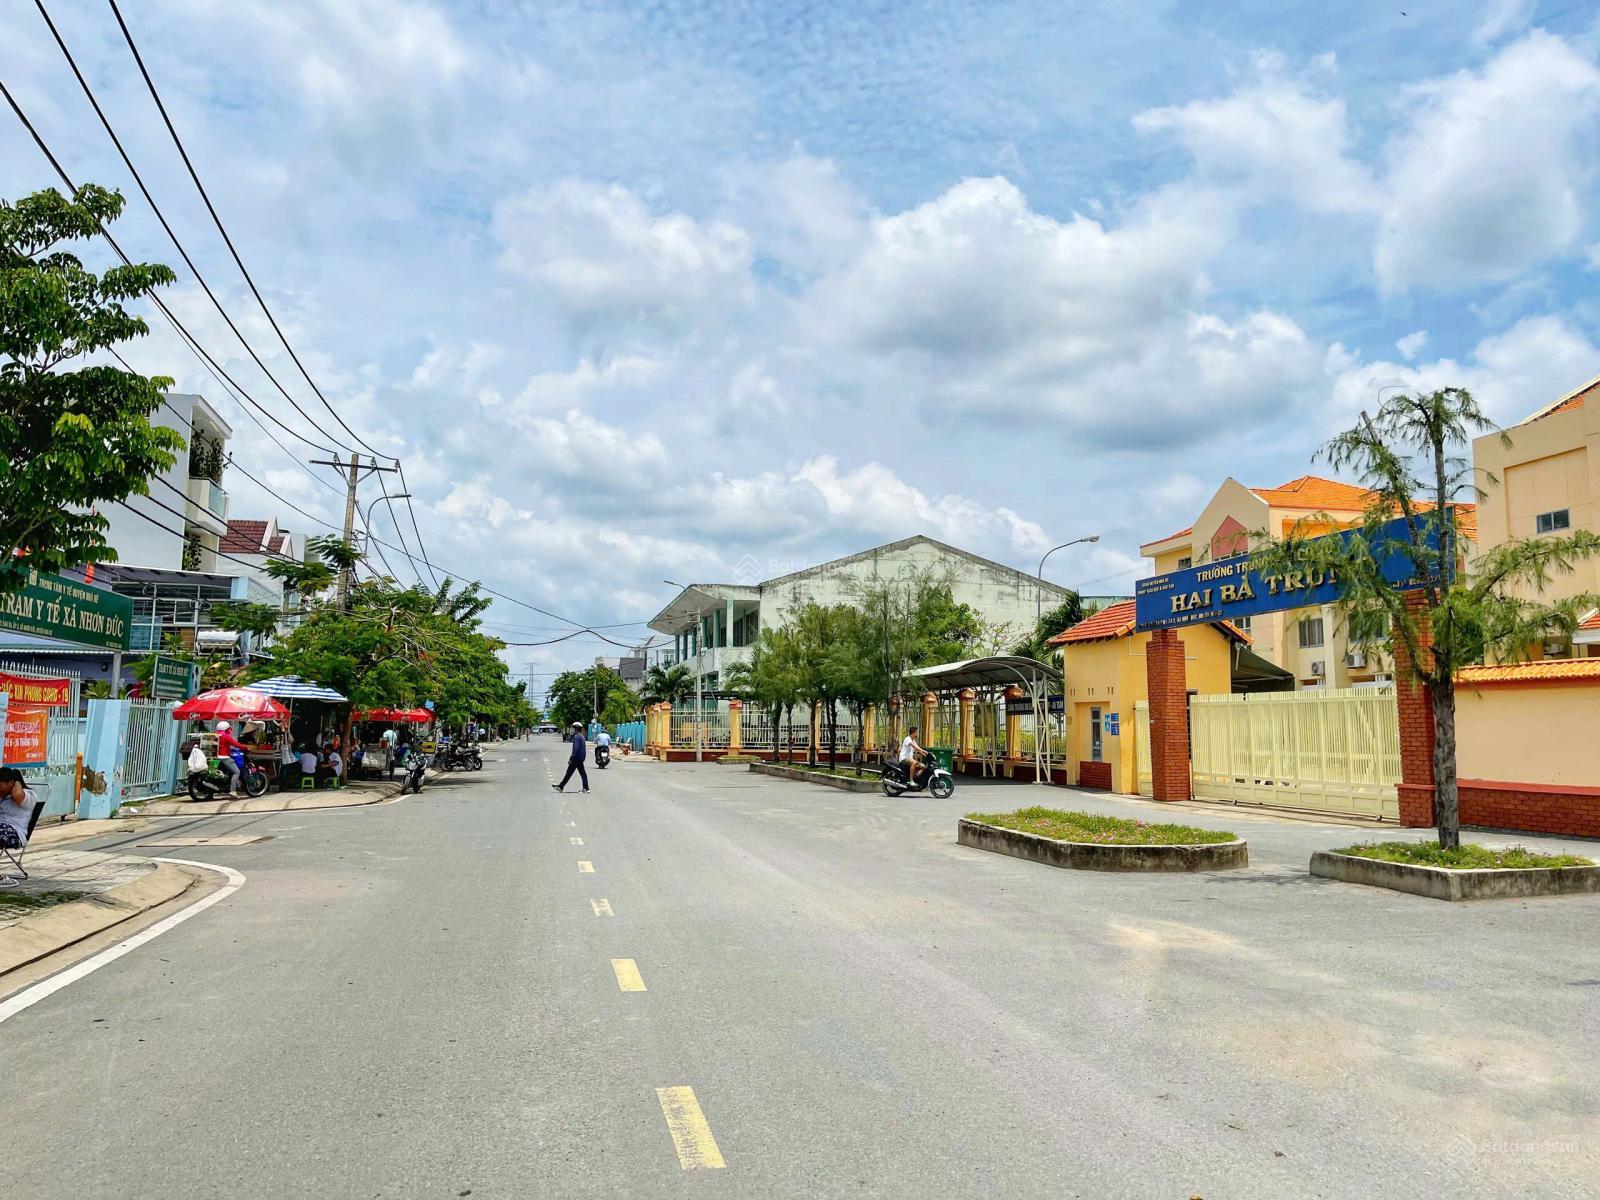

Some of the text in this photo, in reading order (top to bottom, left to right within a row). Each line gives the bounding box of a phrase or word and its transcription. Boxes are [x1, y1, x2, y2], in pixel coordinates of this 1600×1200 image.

[1197, 564, 1233, 582] TRƯỜNG
[1171, 588, 1213, 612] HAI
[0, 592, 34, 621] TRẠM
[36, 599, 44, 620] Y
[47, 596, 61, 624] TẾ
[79, 611, 105, 634] NHƠN
[106, 614, 124, 638] ĐỨC
[62, 687, 69, 703] 19
